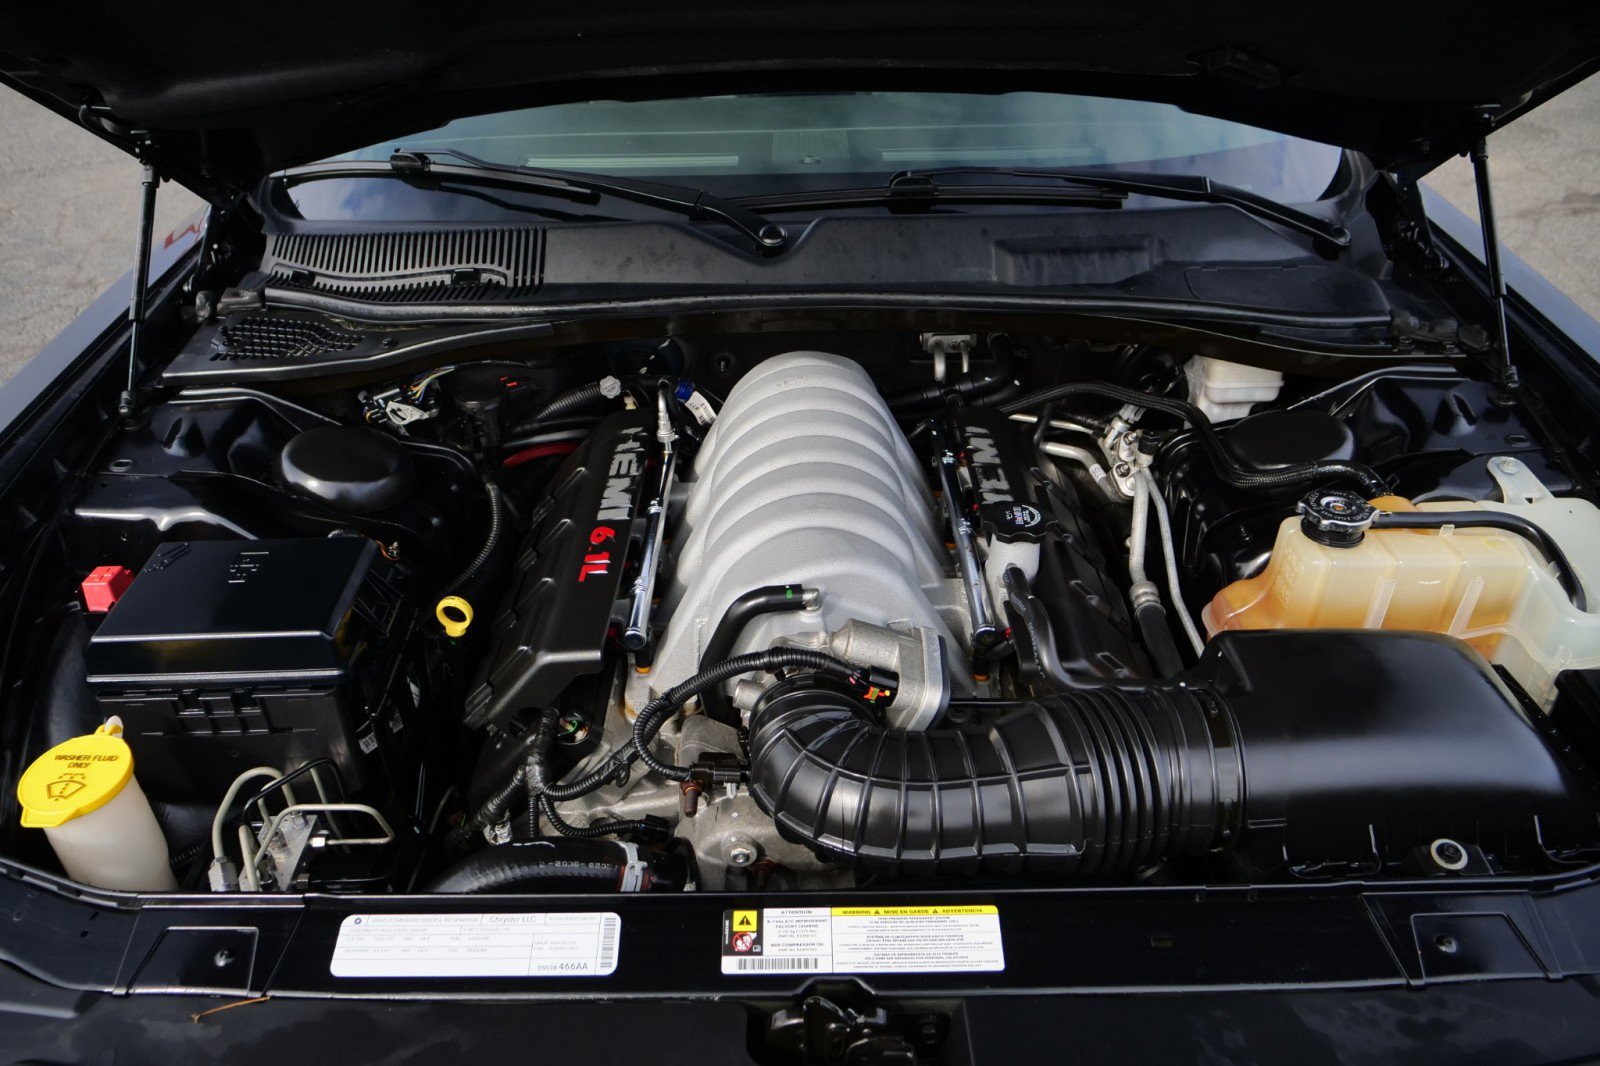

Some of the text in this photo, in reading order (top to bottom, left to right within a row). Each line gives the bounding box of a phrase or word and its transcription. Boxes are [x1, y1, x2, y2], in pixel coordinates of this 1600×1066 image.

[578, 427, 648, 582] HEMI 6.1L
[490, 915, 520, 926] Chrysler
[521, 915, 537, 923] LLC
